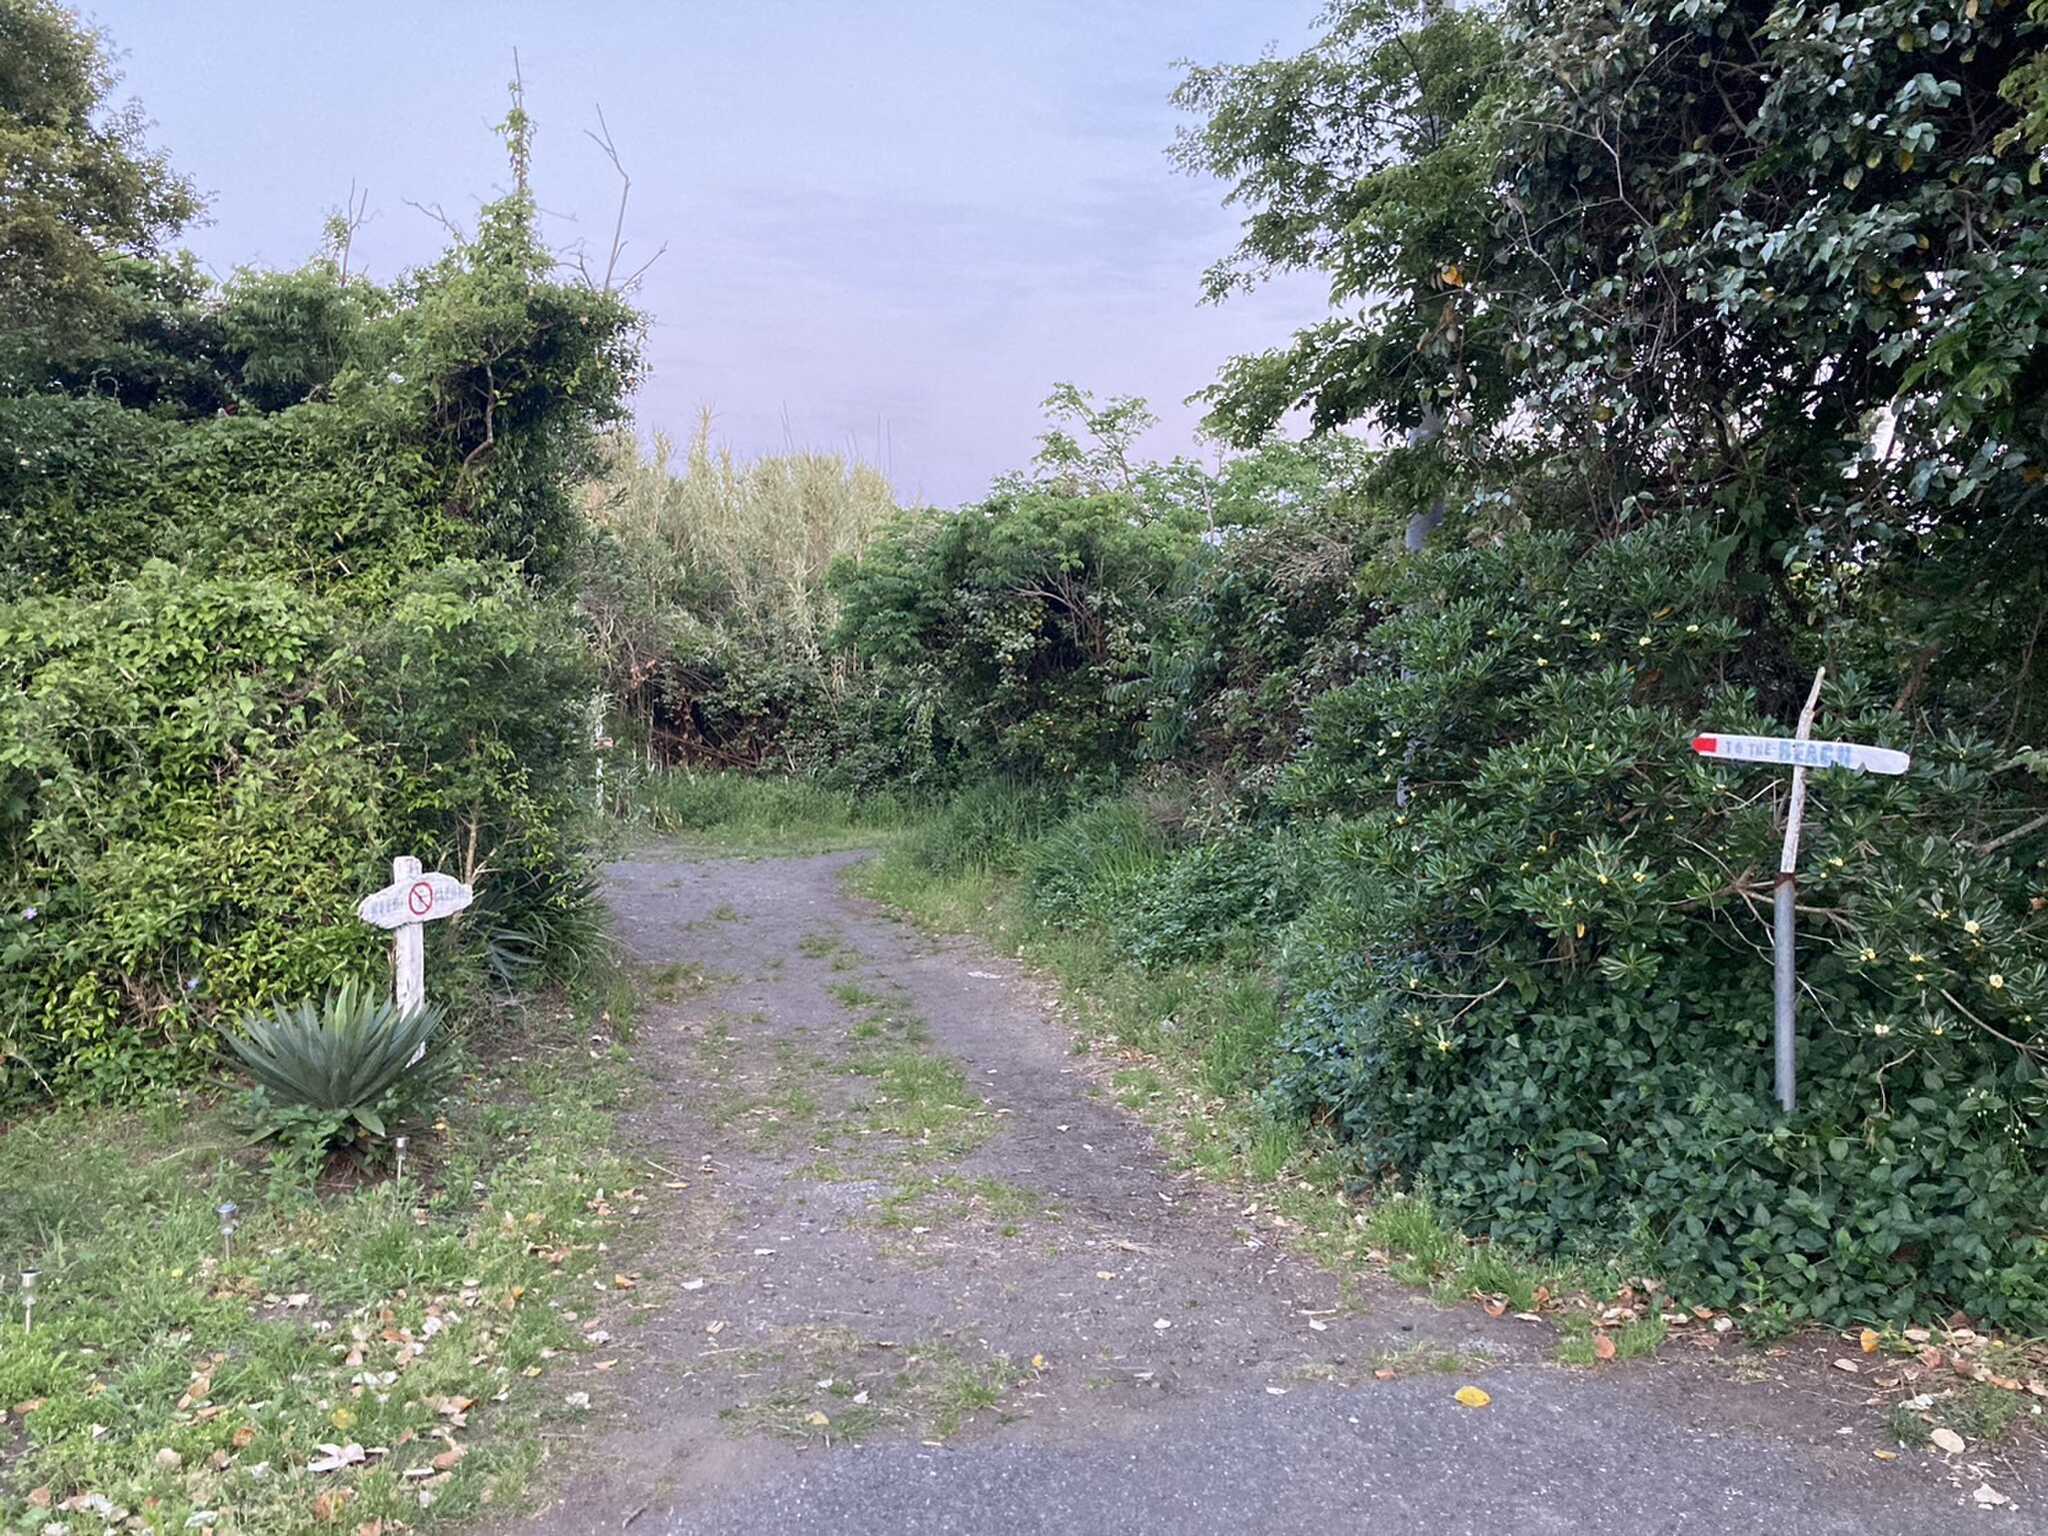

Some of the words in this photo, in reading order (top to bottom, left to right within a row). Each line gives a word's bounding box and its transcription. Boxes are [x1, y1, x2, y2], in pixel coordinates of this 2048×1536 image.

[1726, 741, 1743, 754] TO
[1749, 742, 1772, 756] THE
[1778, 741, 1852, 767] BEACH
